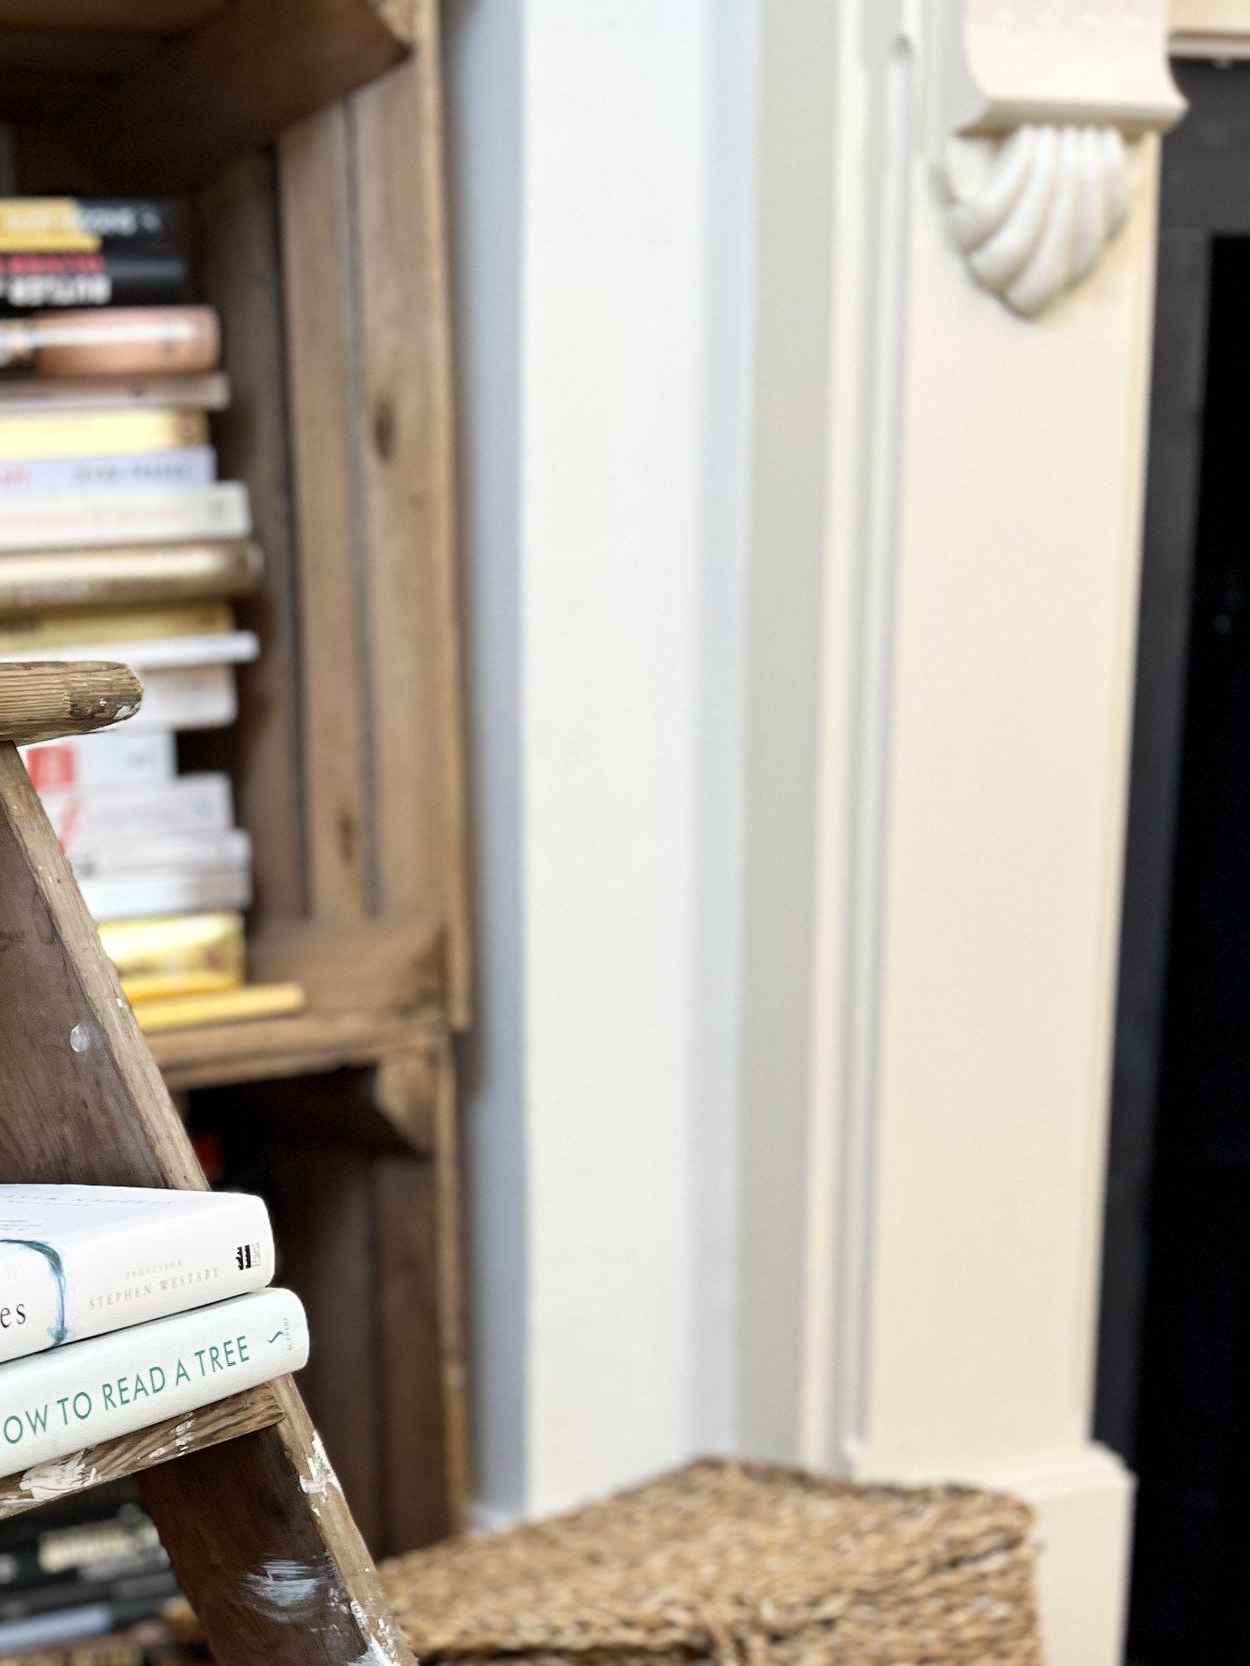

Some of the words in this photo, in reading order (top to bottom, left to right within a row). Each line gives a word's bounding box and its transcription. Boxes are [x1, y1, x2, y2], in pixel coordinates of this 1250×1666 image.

[88, 1283, 152, 1311] STEPHEN
[158, 1266, 221, 1291] WESTABY
[56, 1391, 93, 1426] TO
[101, 1365, 166, 1411] READ
[175, 1357, 191, 1386] A
[194, 1335, 251, 1377] TREE
